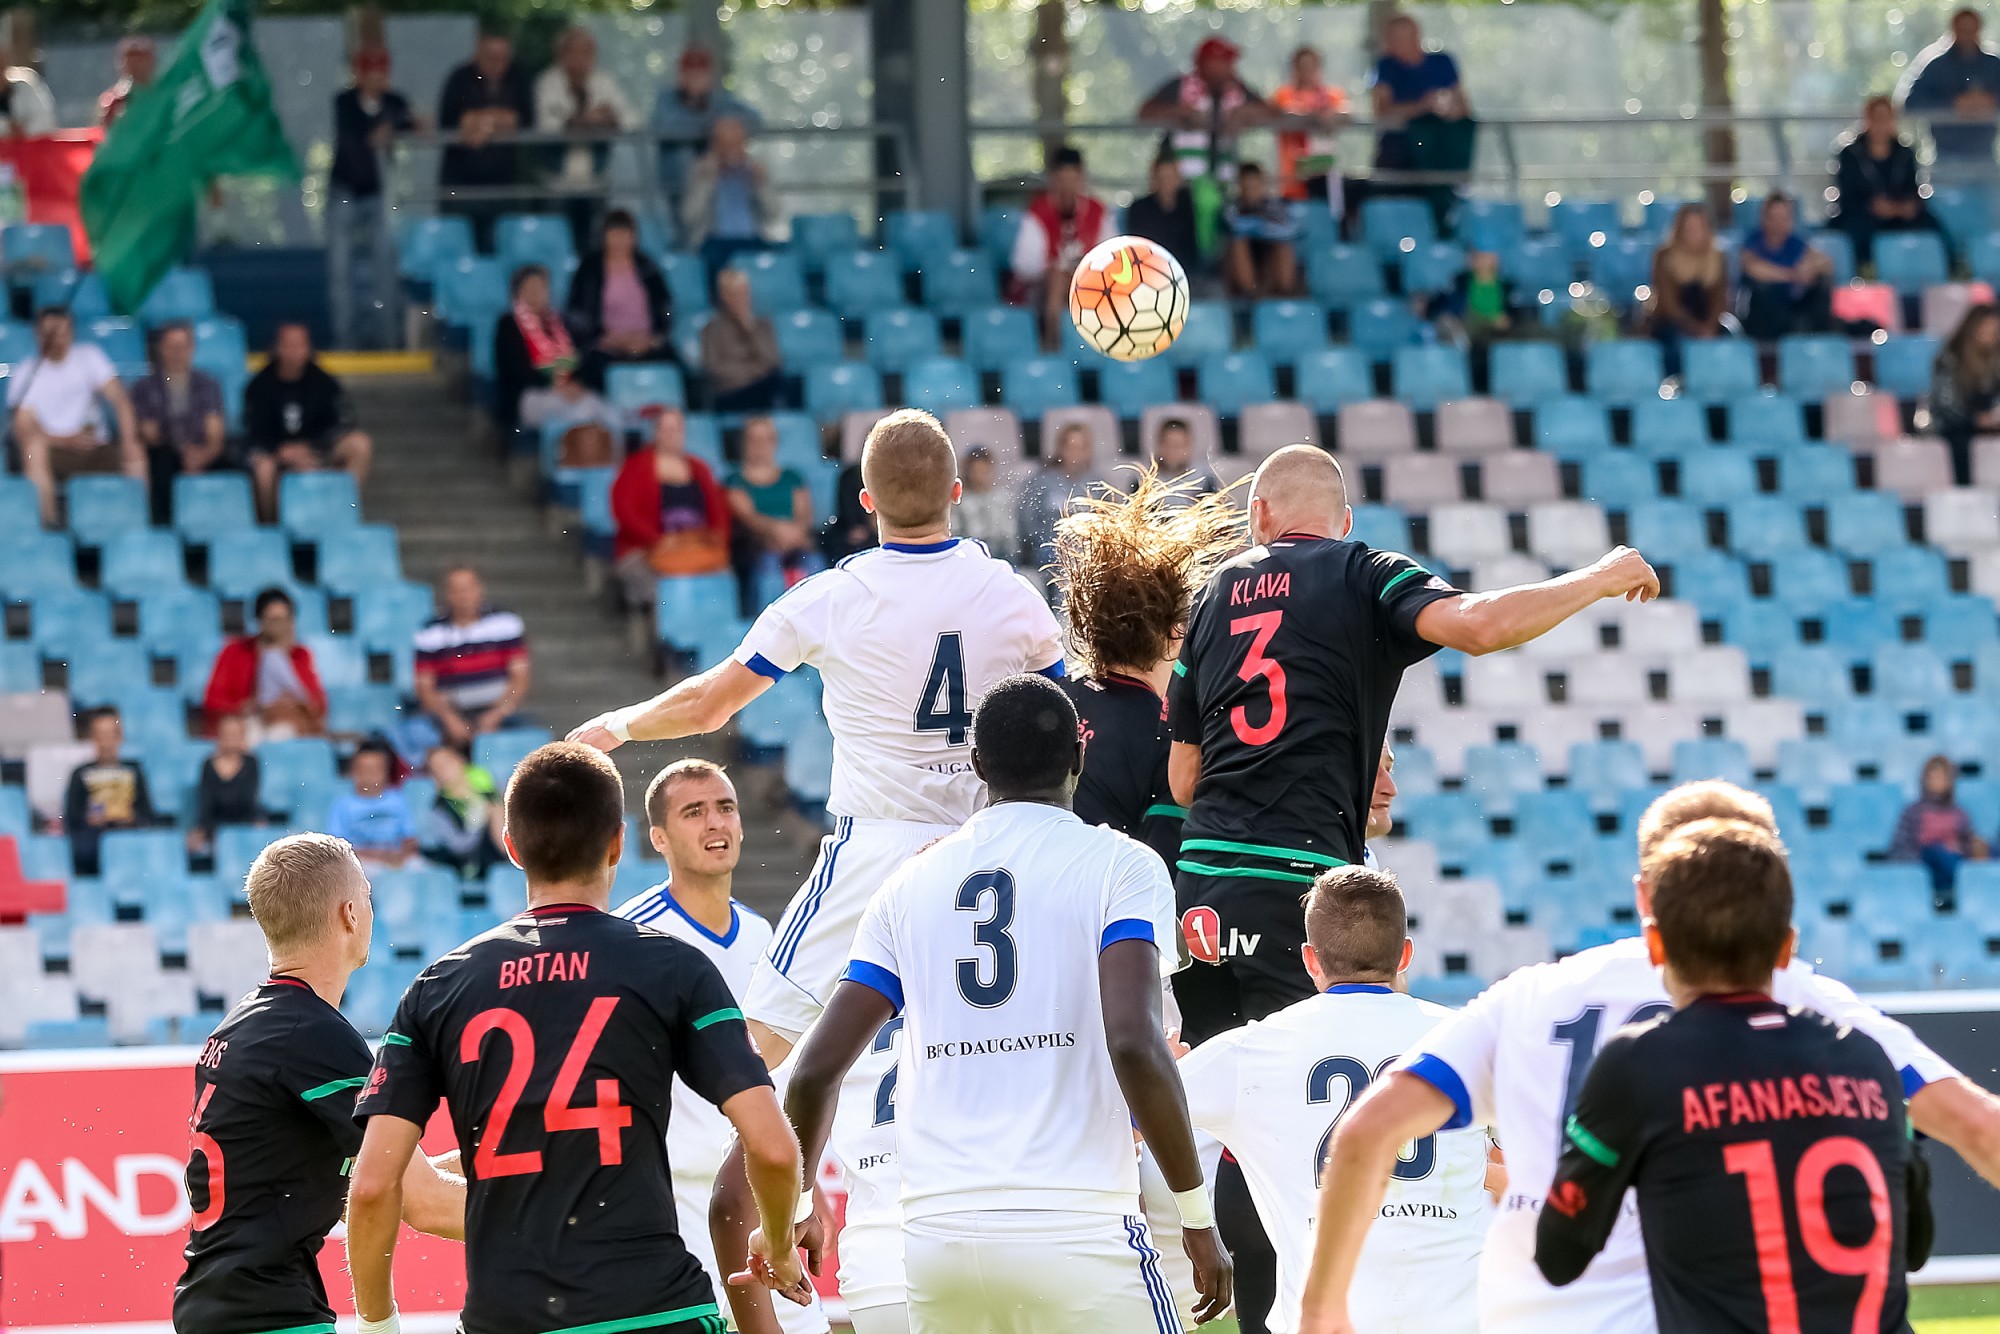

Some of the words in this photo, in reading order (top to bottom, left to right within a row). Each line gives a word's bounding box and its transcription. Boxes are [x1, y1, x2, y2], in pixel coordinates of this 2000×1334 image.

[1230, 572, 1291, 607] KĻAVA
[912, 630, 976, 748] 4
[1230, 610, 1287, 746] 3
[499, 951, 590, 990] BRTAN
[954, 866, 1018, 1009] 3
[460, 996, 633, 1181] 24
[926, 1041, 957, 1060] BFC
[959, 1032, 1076, 1057] DAUGAVPILS
[1682, 1073, 1889, 1134] AFANASJEVS
[0, 1153, 191, 1242] AND
[858, 1152, 892, 1170] BFC
[1722, 1135, 1893, 1334] 19
